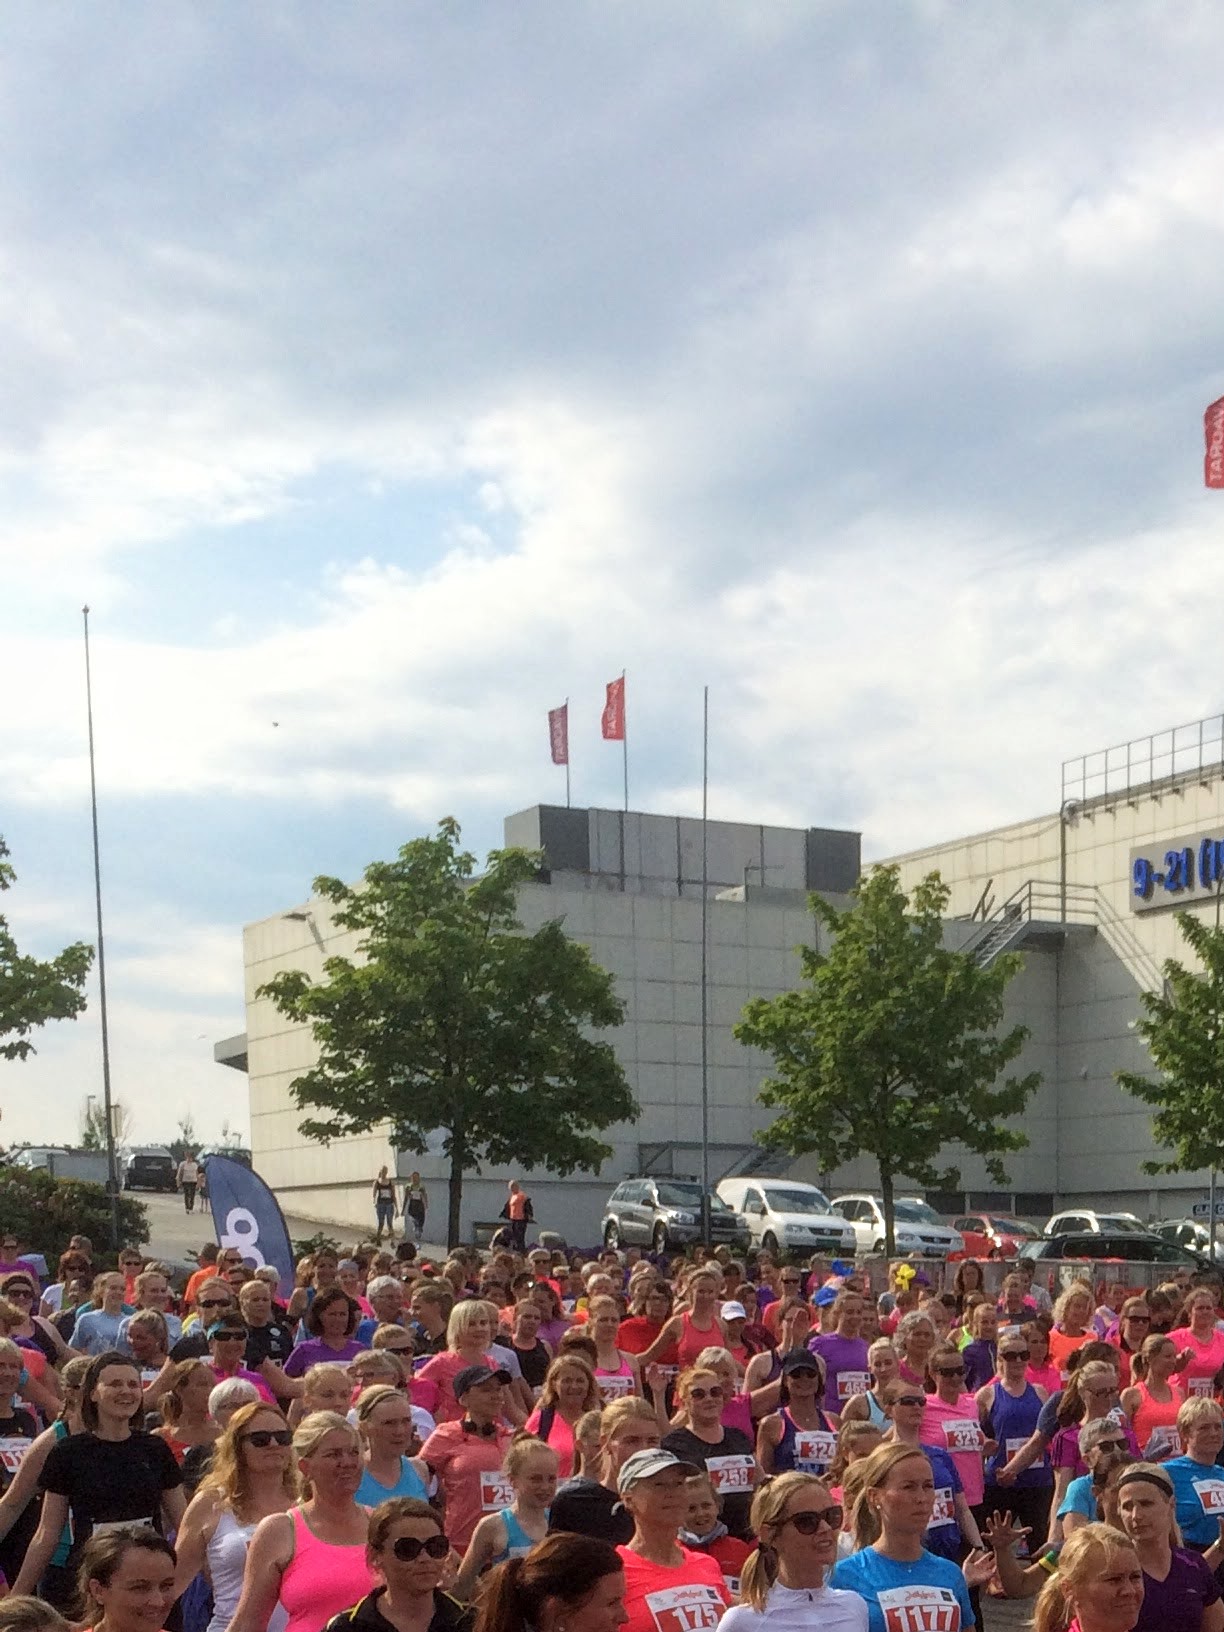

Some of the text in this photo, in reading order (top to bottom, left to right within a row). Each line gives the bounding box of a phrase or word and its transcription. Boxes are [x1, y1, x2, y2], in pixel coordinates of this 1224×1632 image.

[1133, 847, 1188, 897] 9-21
[955, 1430, 980, 1447] 325
[718, 1468, 748, 1487] 258
[671, 1603, 718, 1632] 175
